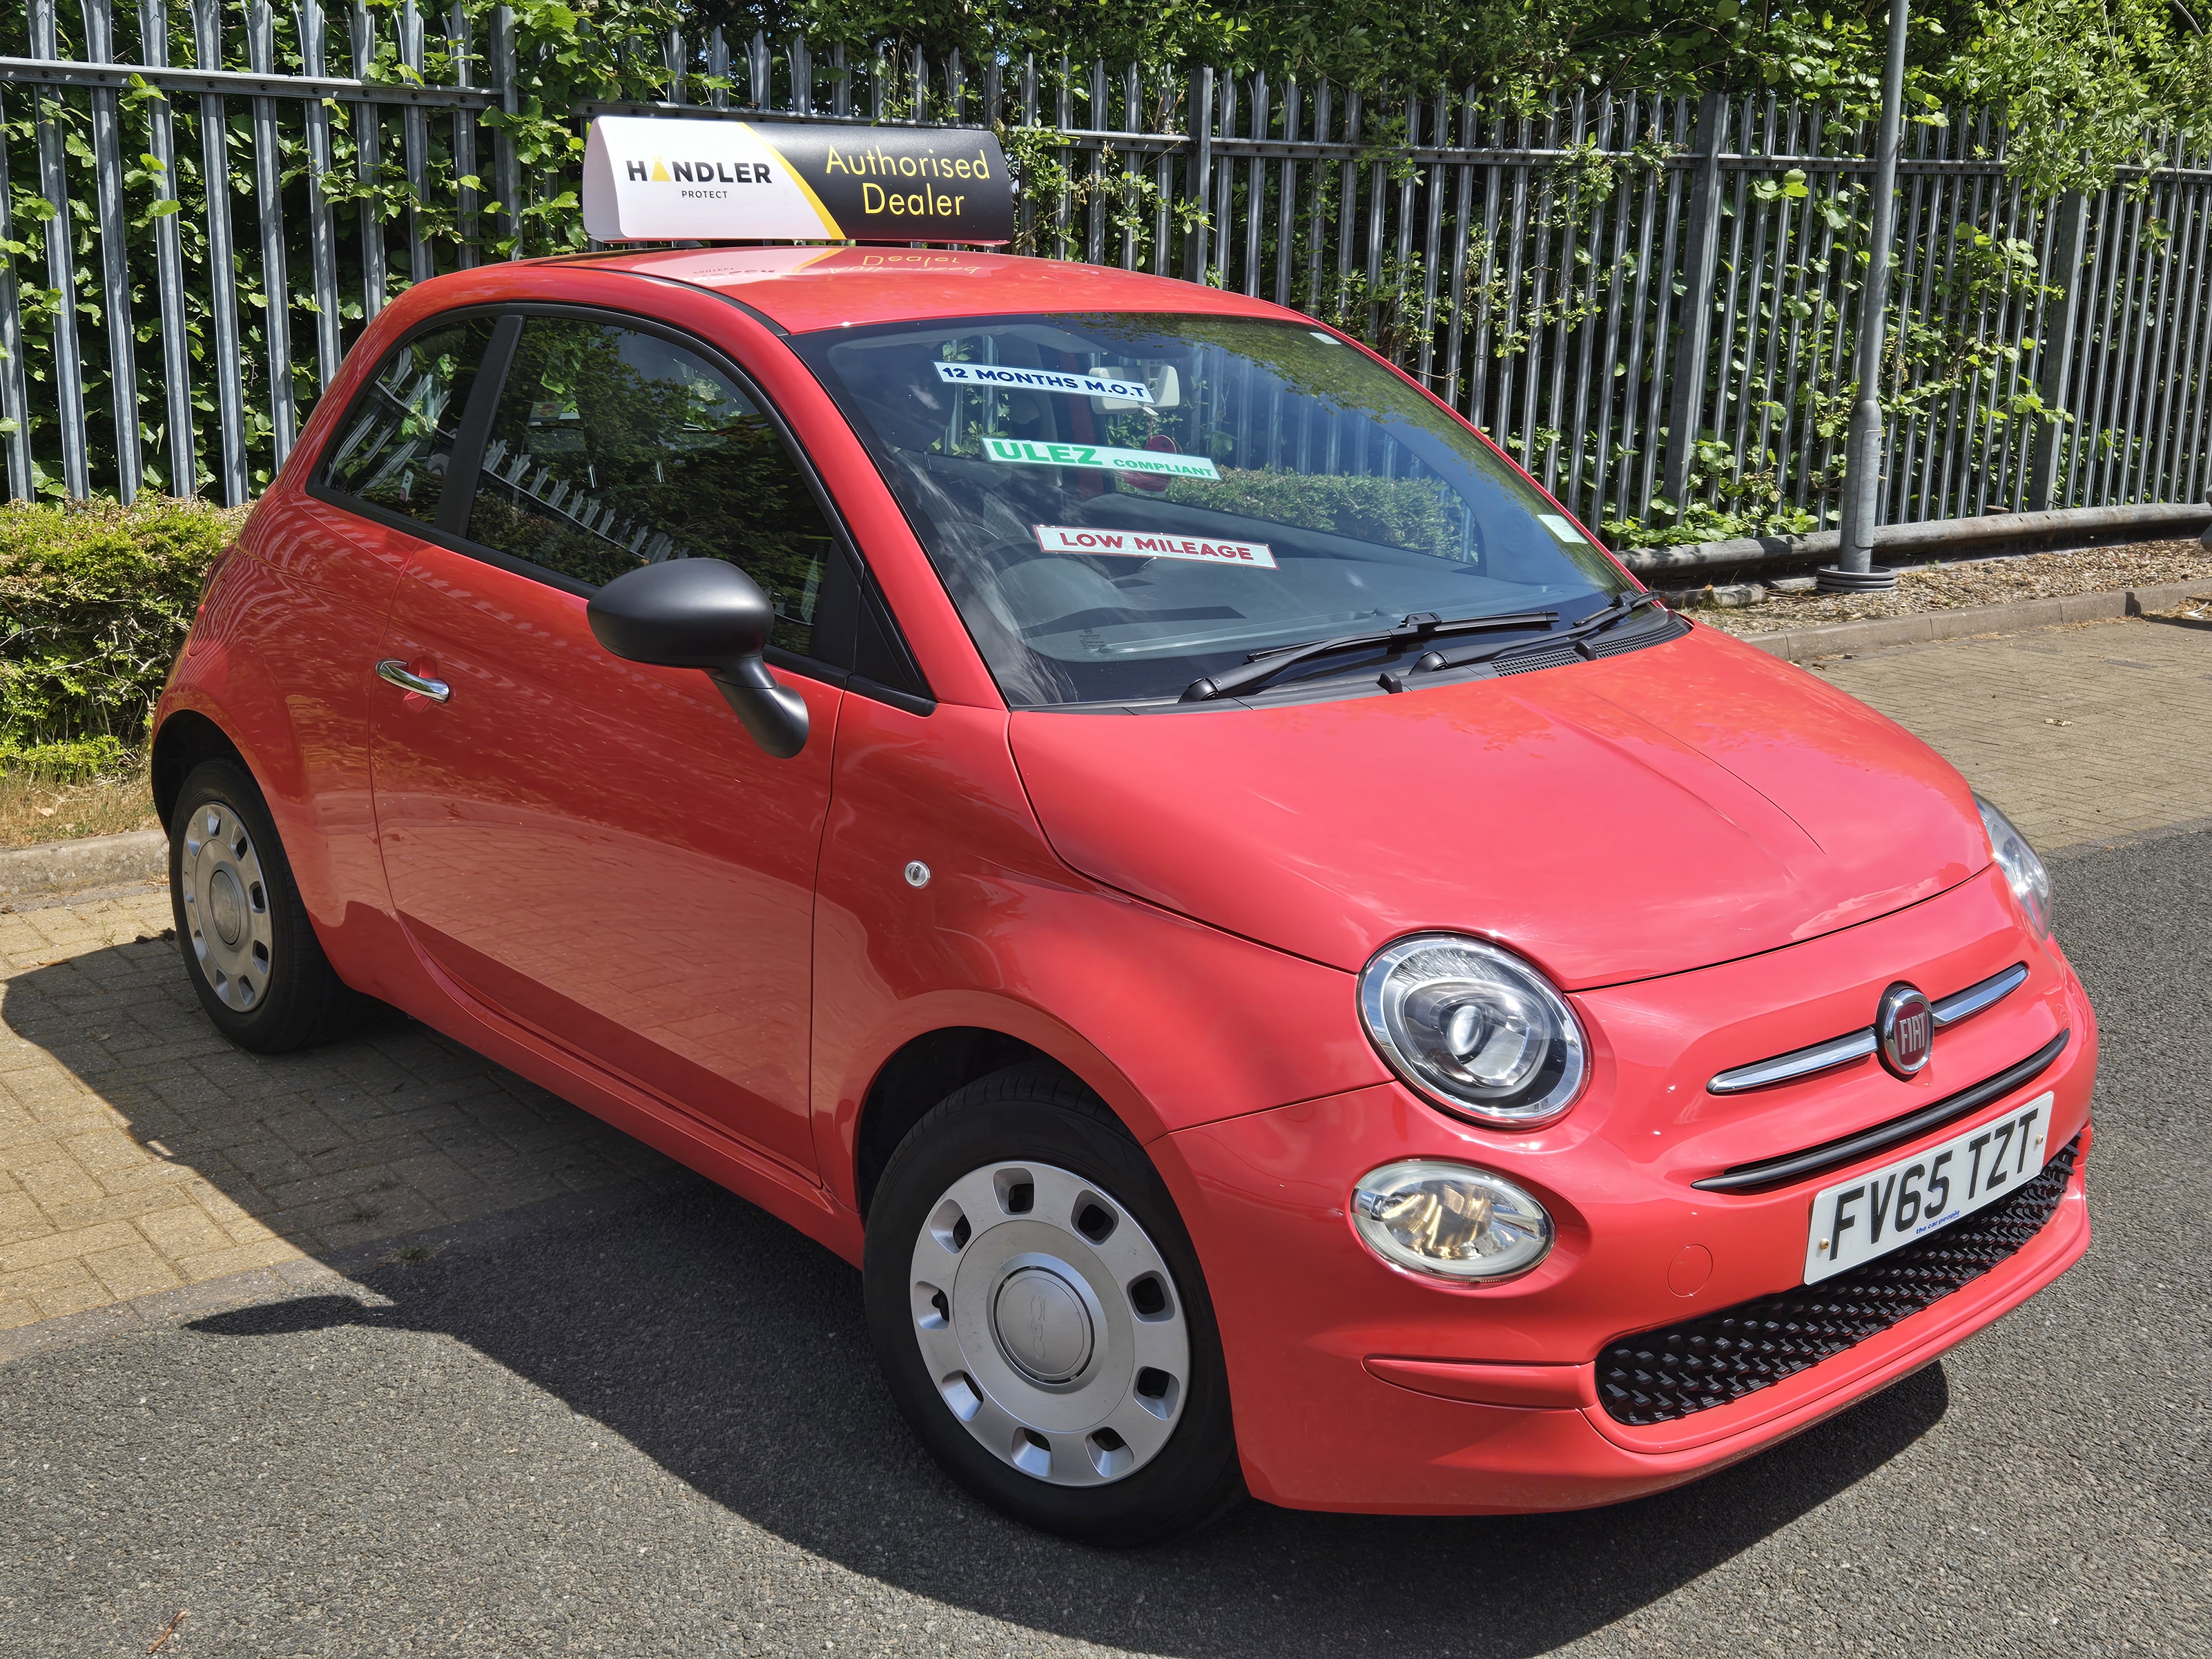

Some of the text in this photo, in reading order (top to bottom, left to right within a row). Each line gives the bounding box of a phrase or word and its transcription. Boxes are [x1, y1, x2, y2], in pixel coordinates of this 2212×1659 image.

[826, 144, 990, 179] Authorised
[681, 190, 728, 199] PROTECT
[862, 182, 965, 216] Dealer
[942, 367, 1144, 398] 12 MONTHS M.O.T
[991, 441, 1213, 477] ULEZ COMPLIANT
[1059, 533, 1255, 561] LOW MILEAGE
[1899, 1012, 1926, 1055] FIAT
[1829, 1108, 2039, 1261] FV65 TZT
